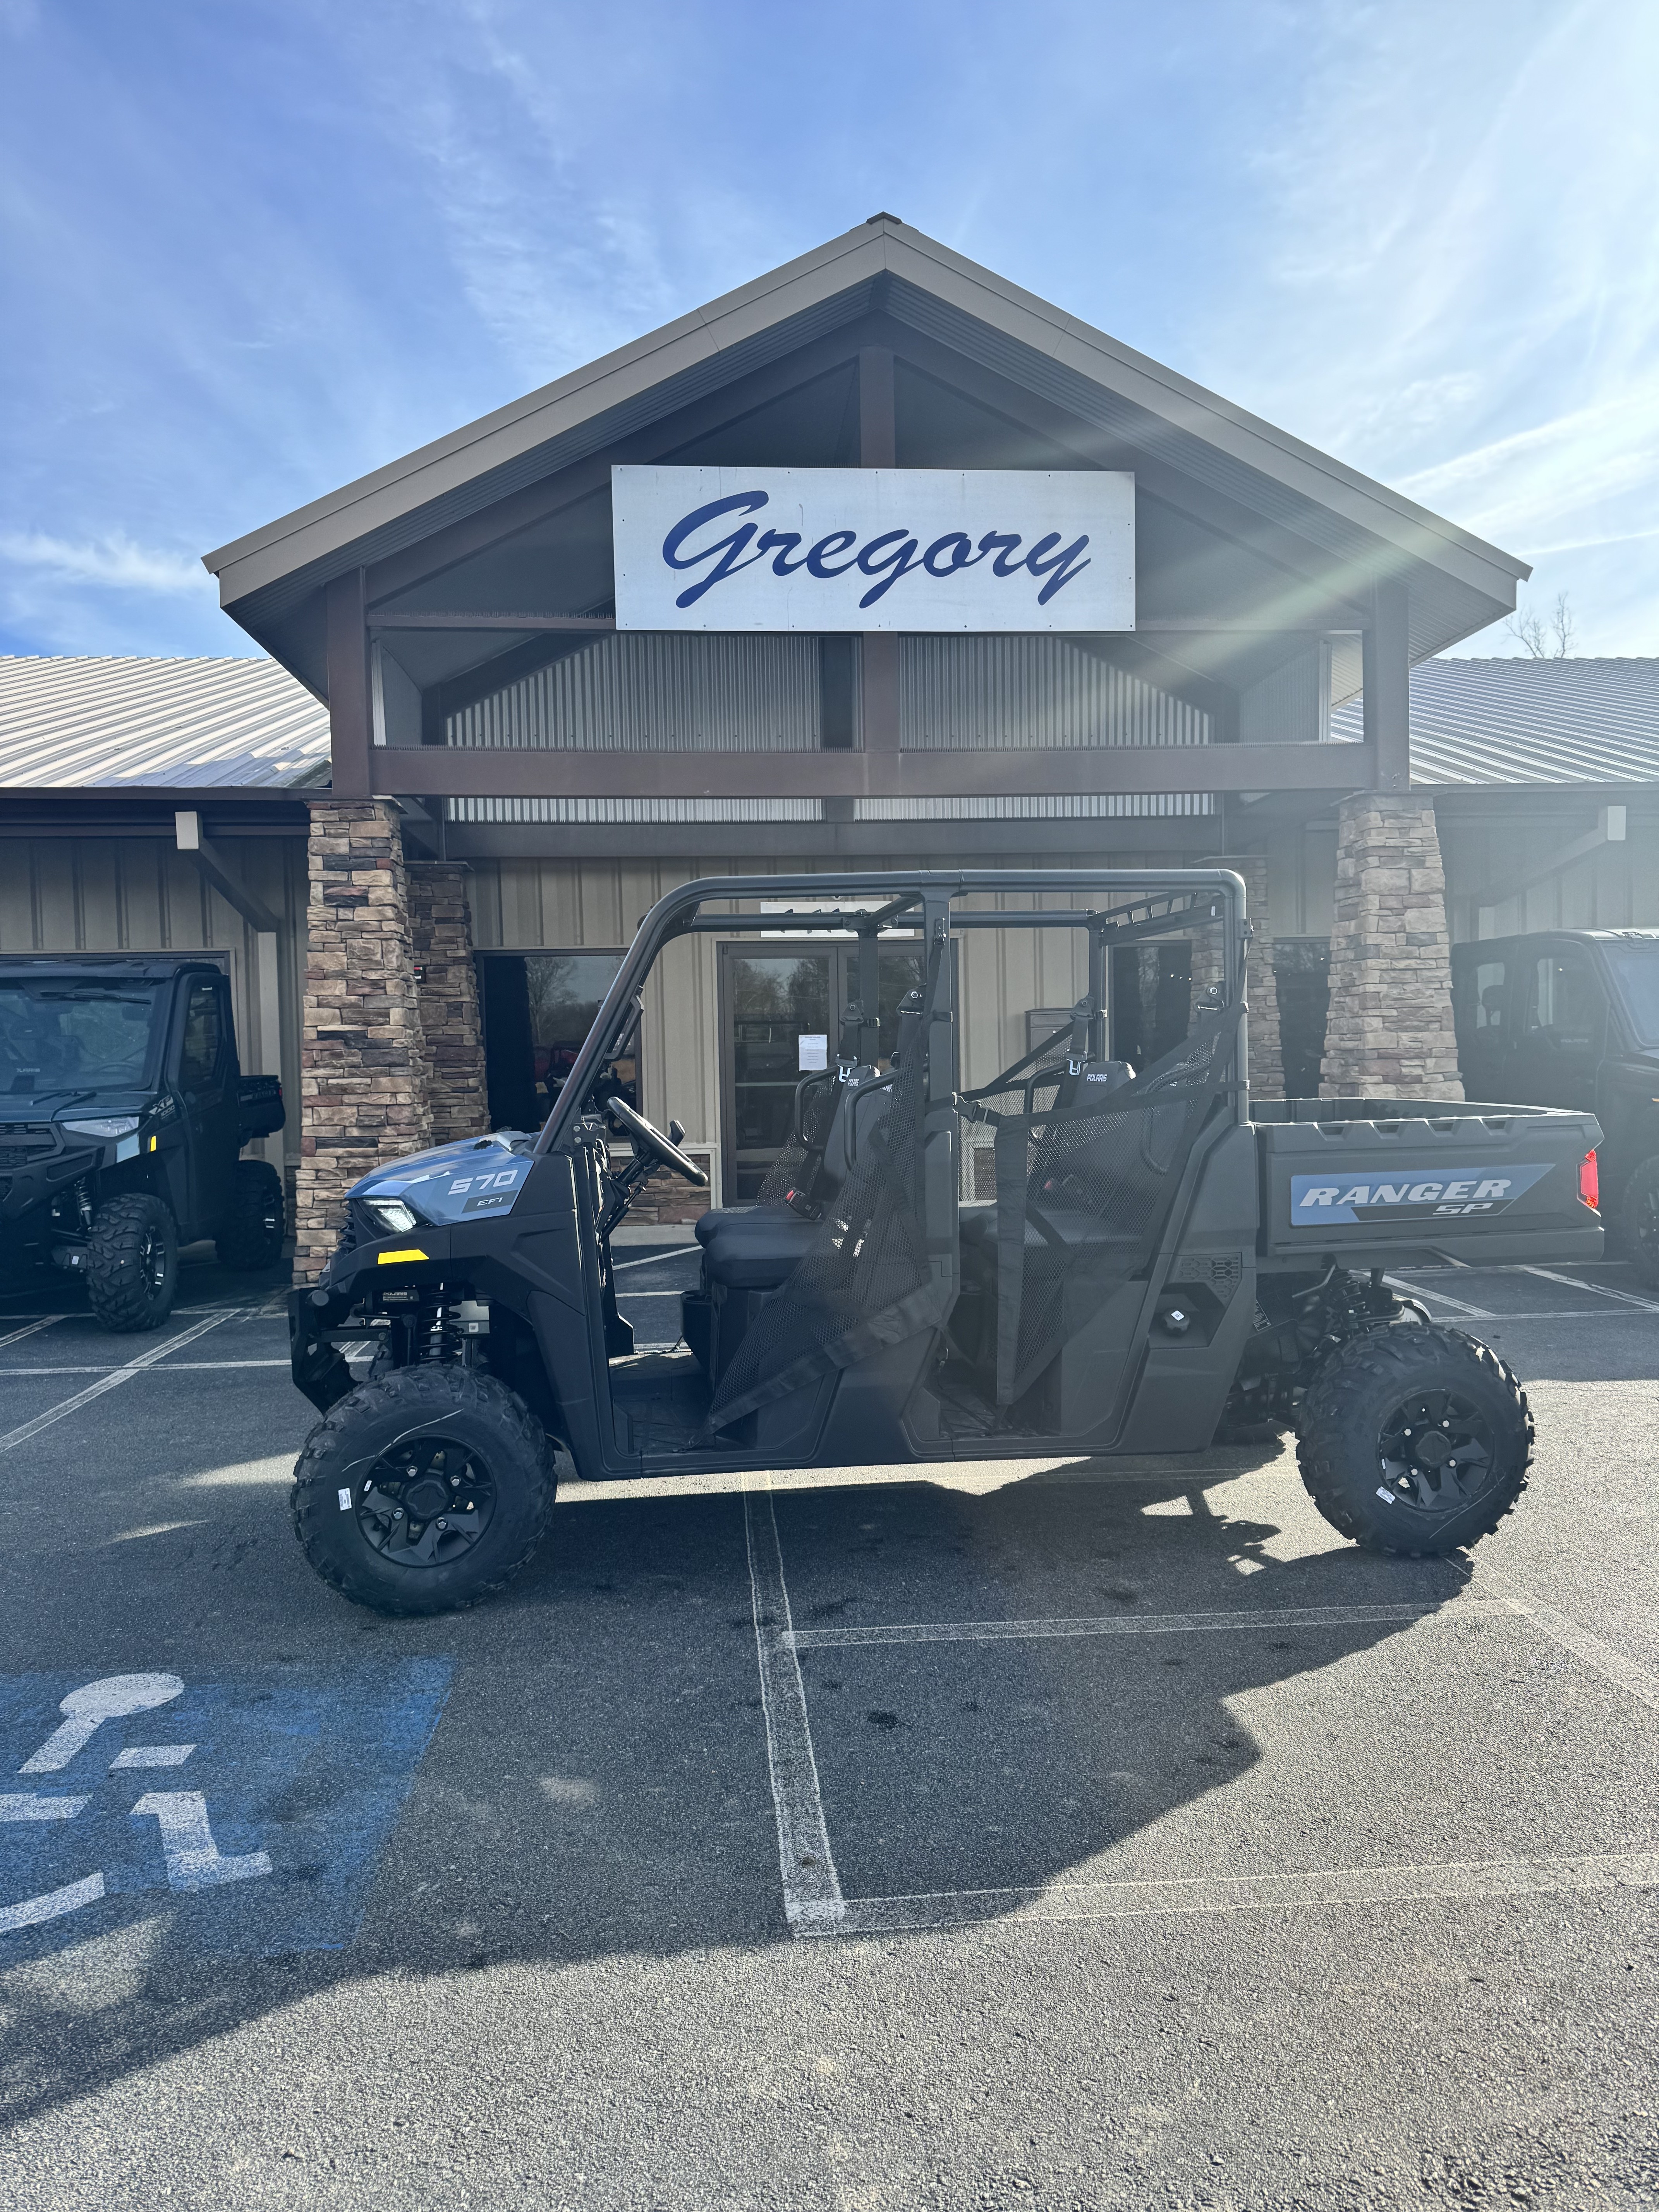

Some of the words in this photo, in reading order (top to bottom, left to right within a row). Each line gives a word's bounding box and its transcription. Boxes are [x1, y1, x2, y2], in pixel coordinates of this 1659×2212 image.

[663, 490, 1091, 609] Gregory
[1086, 1073, 1107, 1082] POLARIS
[152, 1095, 172, 1115] XP
[161, 1104, 175, 1117] 1000
[447, 1170, 518, 1195] 570
[1299, 1179, 1511, 1207] RANGER
[477, 1197, 503, 1206] EFI
[1432, 1202, 1494, 1215] SP
